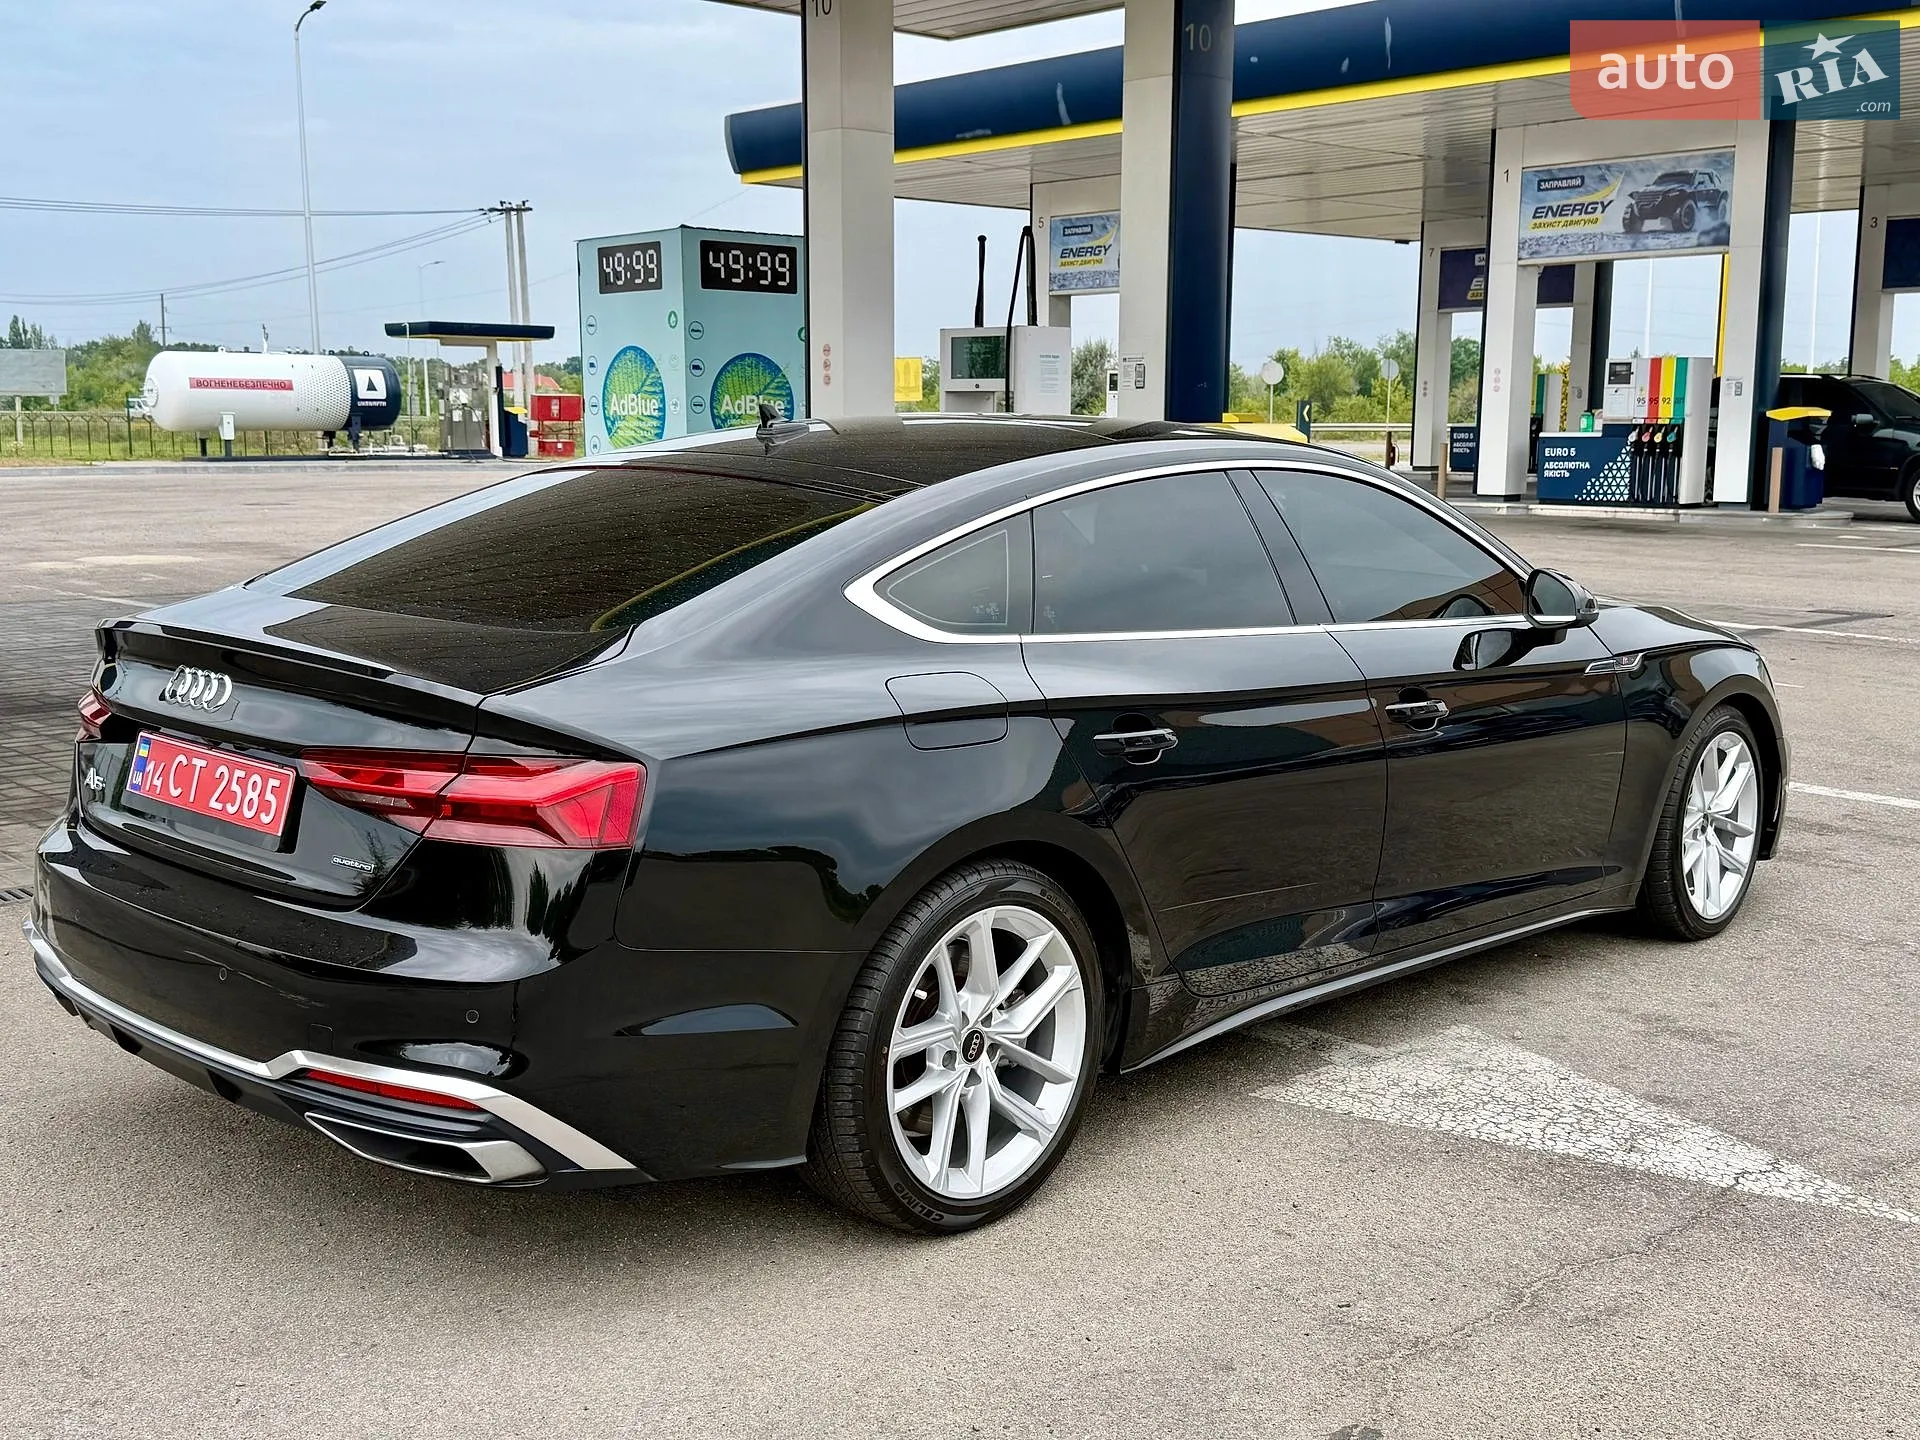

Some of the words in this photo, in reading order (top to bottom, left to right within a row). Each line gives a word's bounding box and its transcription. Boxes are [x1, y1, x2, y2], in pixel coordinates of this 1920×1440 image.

[1185, 23, 1211, 52] 10
[1503, 168, 1509, 183] 1
[1540, 177, 1581, 189] ЗАПРАВЛЯЙ
[1532, 200, 1614, 219] ENERGY
[1038, 217, 1044, 229] 5
[1870, 216, 1878, 229] 3
[1060, 244, 1112, 259] ENERGY
[1429, 247, 1435, 257] 7
[602, 249, 658, 286] 49:99
[709, 250, 790, 286] 49:99
[196, 379, 287, 389] ВОГНЕНЕБЕЗПЕЧНО
[610, 393, 659, 416] AdBlue
[720, 394, 785, 416] AdBe
[1636, 397, 1646, 405] 95
[1662, 397, 1671, 405] 92
[1544, 448, 1569, 457] EURO
[1570, 448, 1577, 457] 5
[1543, 461, 1591, 470] АБСОЛЮТНА
[1543, 470, 1570, 478] ЯКІСТЬ
[133, 771, 143, 785] UA
[333, 857, 372, 871] quattro
